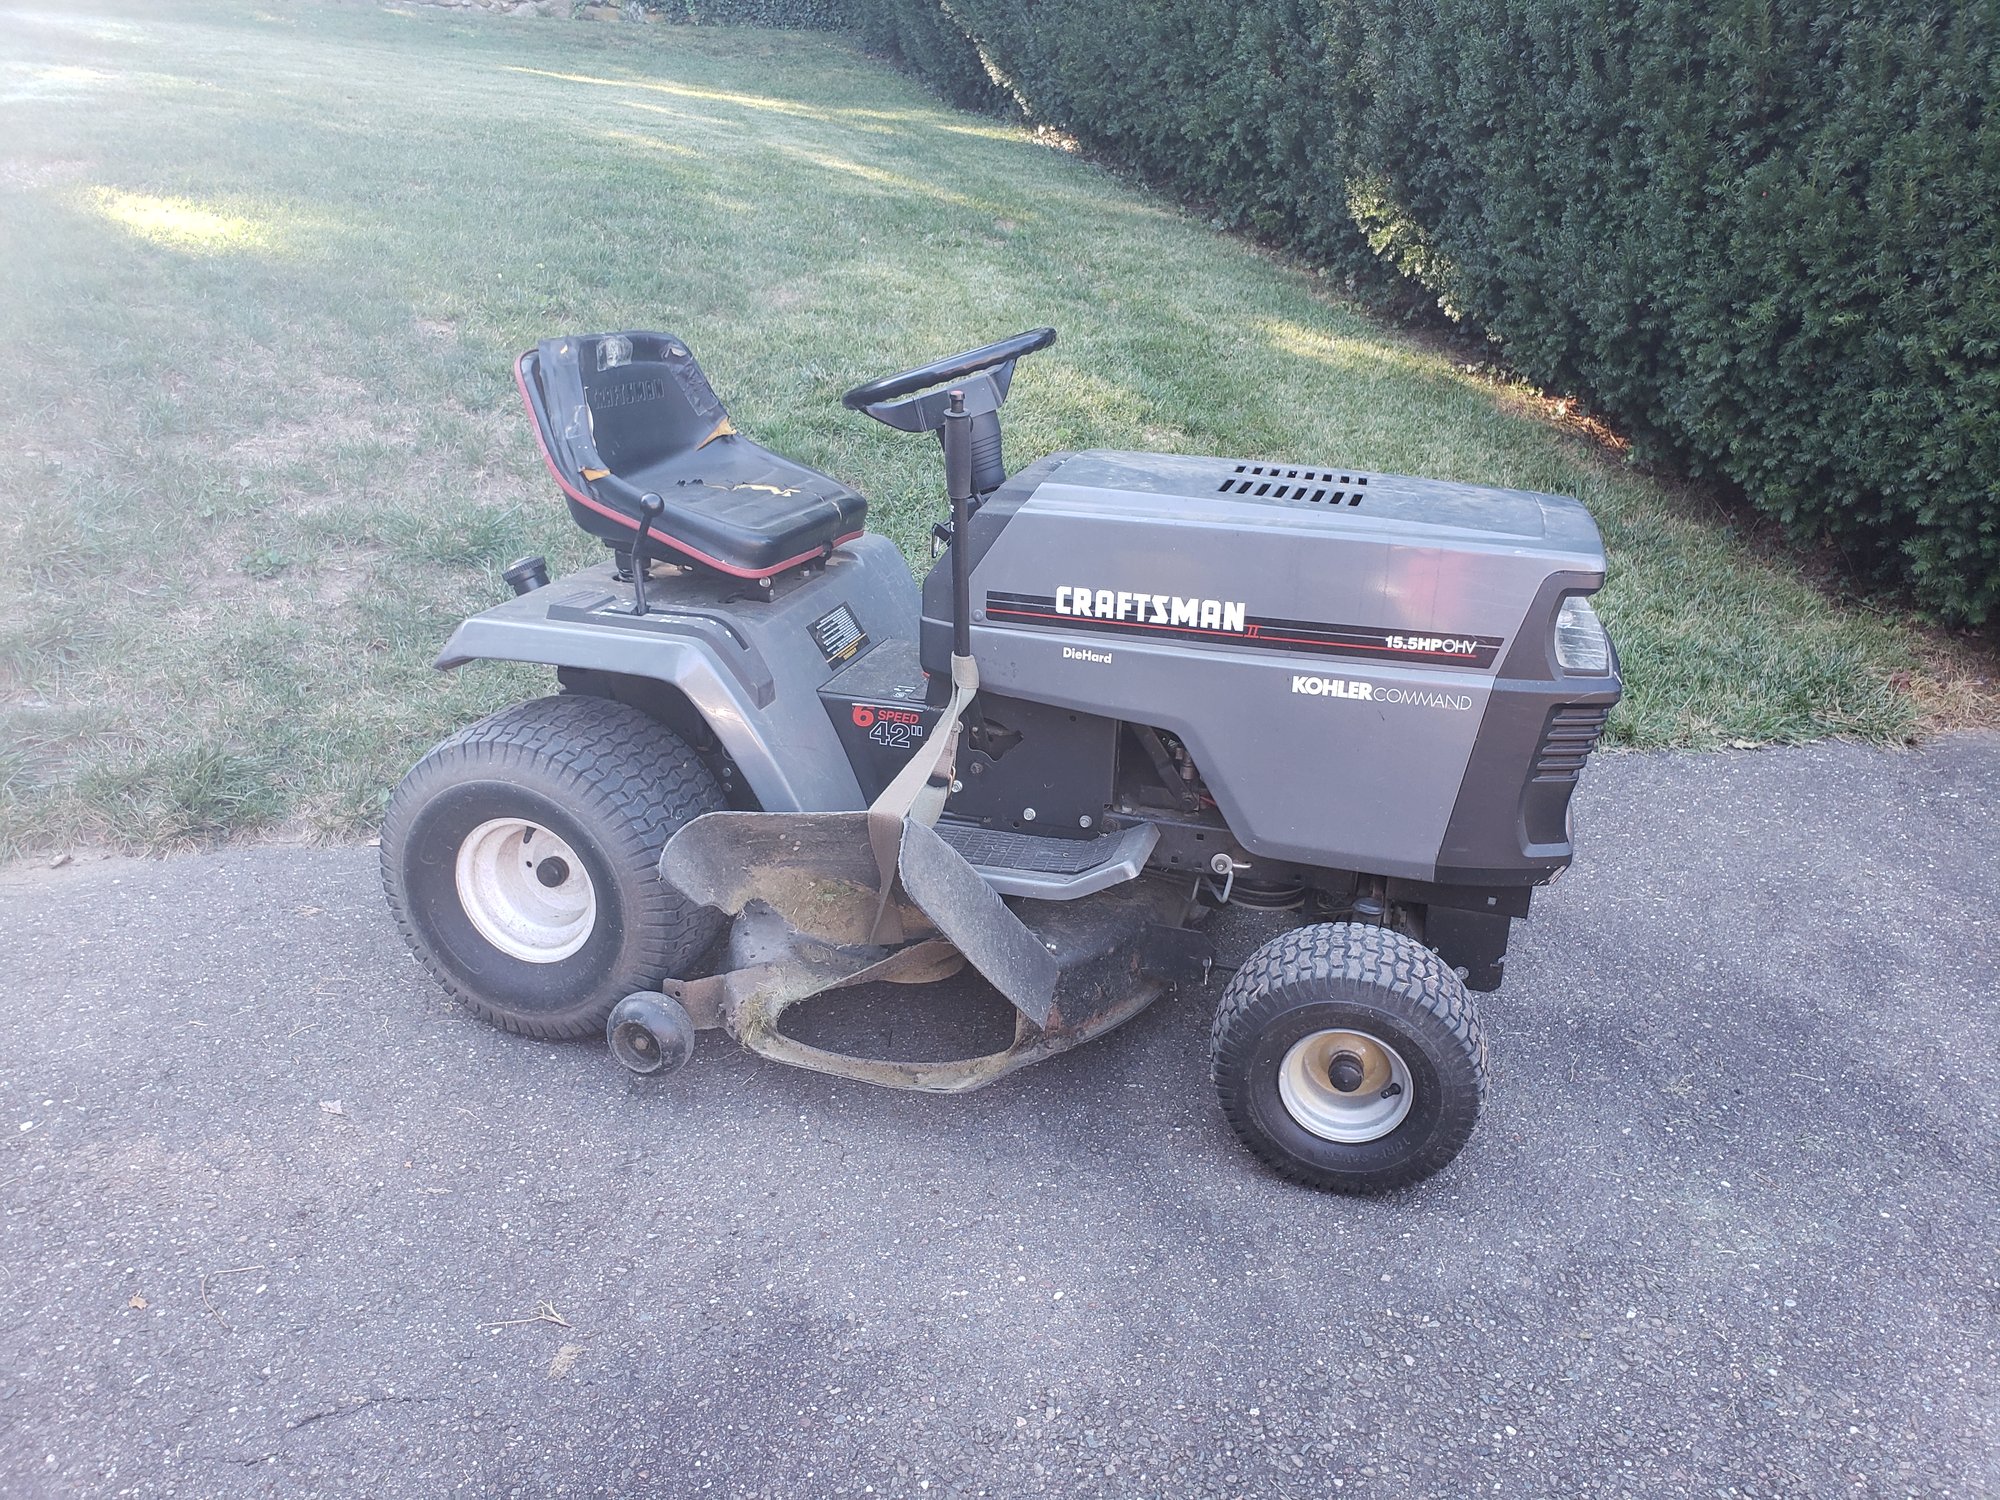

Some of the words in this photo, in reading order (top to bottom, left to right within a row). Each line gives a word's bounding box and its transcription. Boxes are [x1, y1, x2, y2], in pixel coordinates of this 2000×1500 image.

[1055, 585, 1246, 632] CRAFTSMAN
[1062, 647, 1113, 665] DieHard
[852, 706, 875, 727] 6
[877, 710, 919, 724] SPEED
[869, 721, 923, 749] 42"
